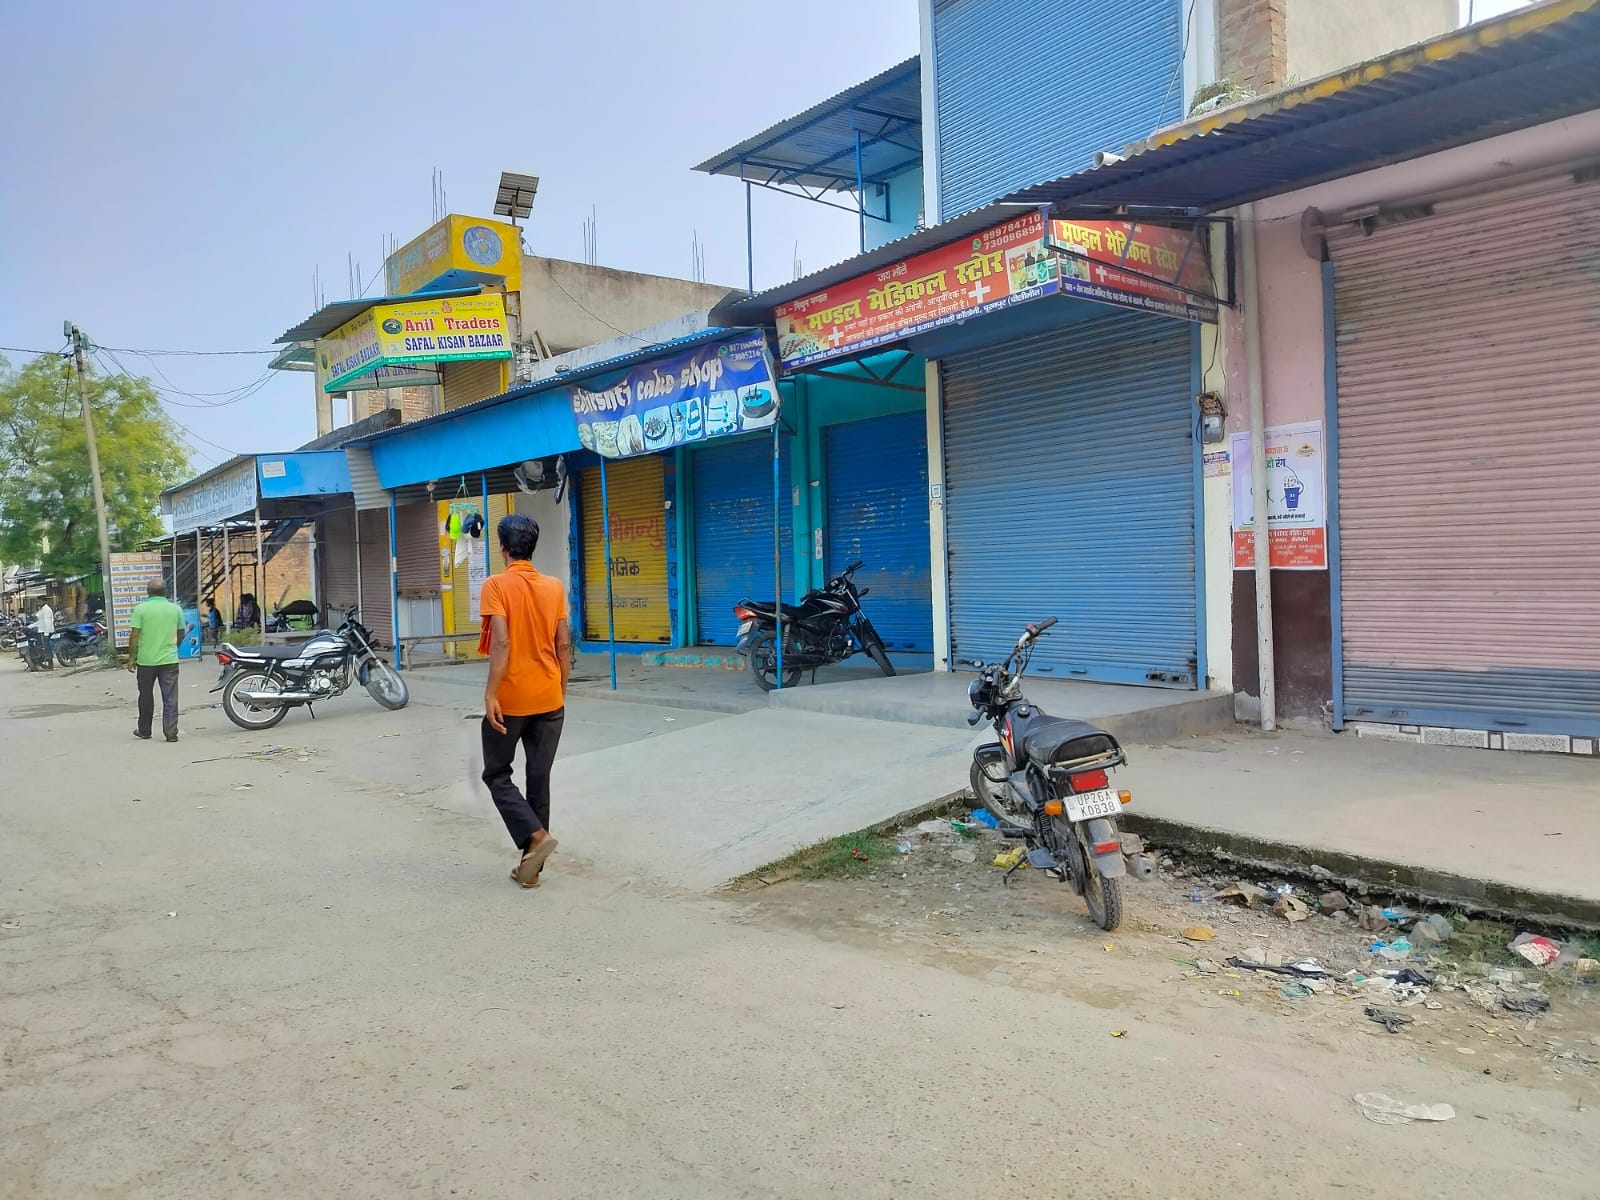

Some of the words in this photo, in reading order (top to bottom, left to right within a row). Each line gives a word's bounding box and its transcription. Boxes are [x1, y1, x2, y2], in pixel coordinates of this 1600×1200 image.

[1060, 221, 1102, 252] मण्डल
[1105, 227, 1152, 265] मेडिकल
[877, 273, 891, 282] जय
[806, 299, 861, 330] मण्डल
[867, 269, 947, 311] मेडिकल
[954, 249, 1004, 285] स्टोर
[928, 309, 937, 319] पर
[405, 318, 435, 332] Anil
[444, 316, 500, 330] Traders
[405, 337, 435, 351] SAFAL
[437, 335, 466, 349] KISAN
[468, 333, 504, 348] BAZAAR
[680, 356, 723, 390] shop
[1275, 456, 1286, 468] रंग
[1080, 801, 1116, 817] K0838
